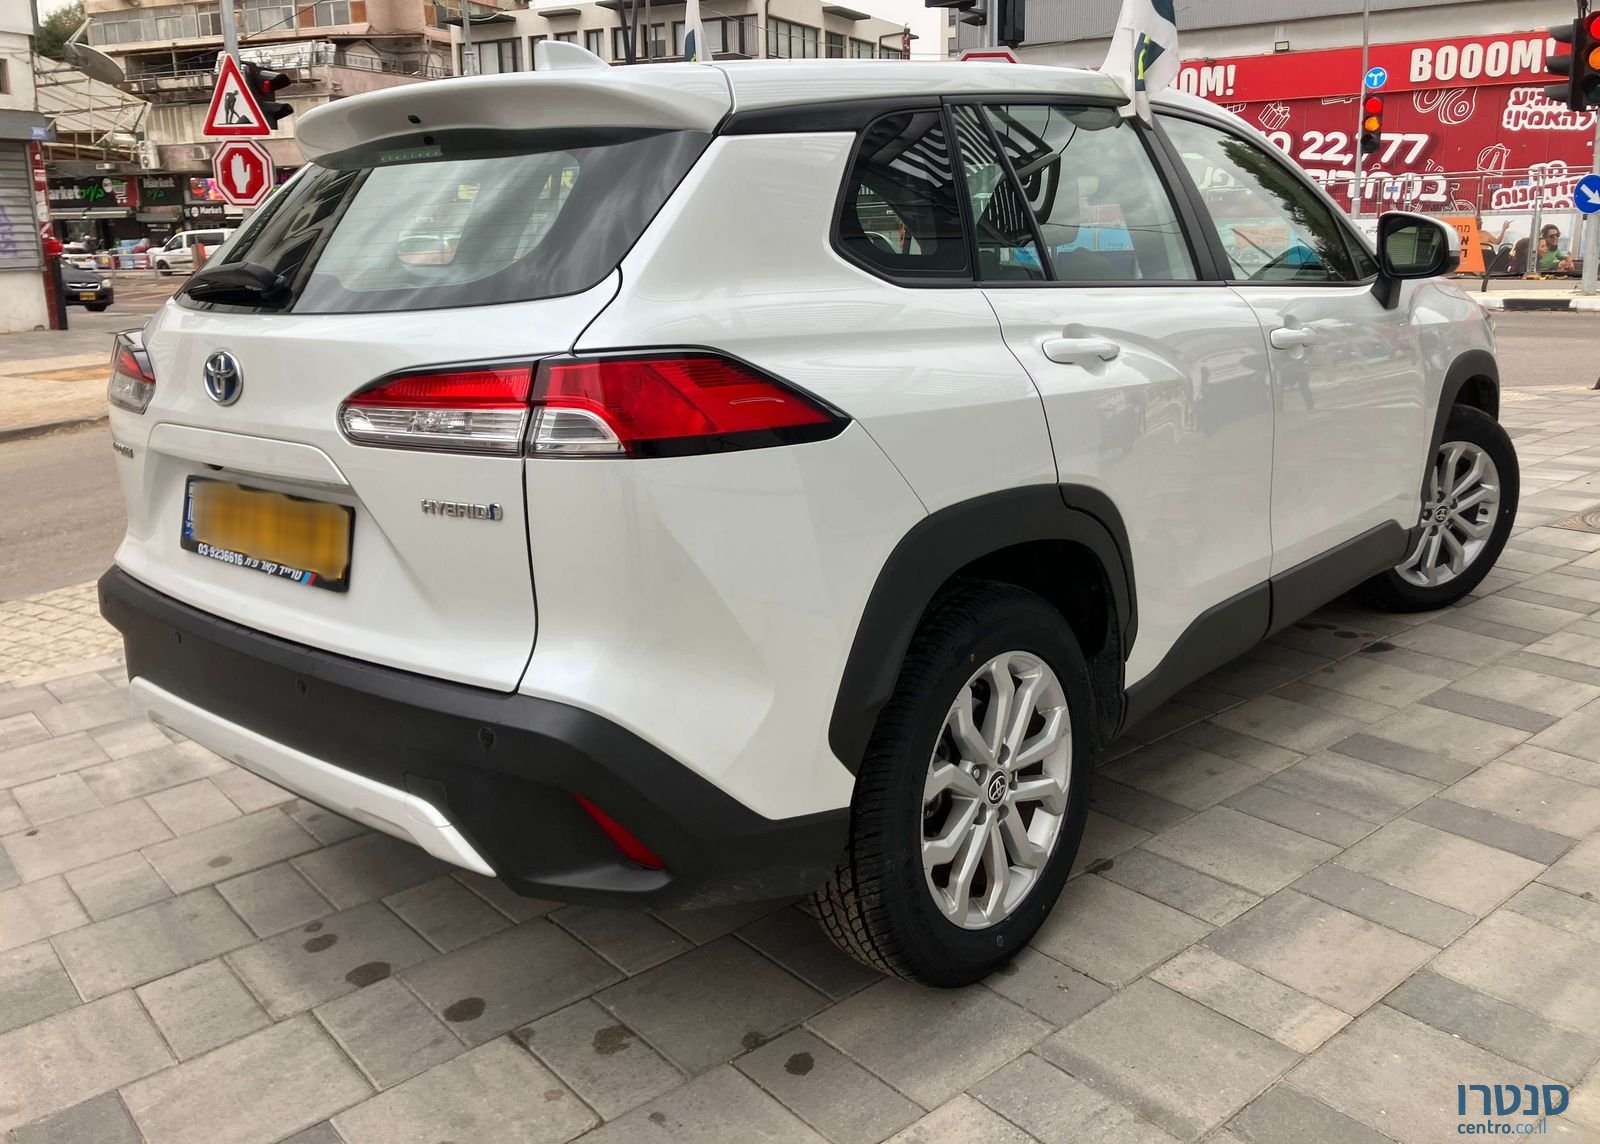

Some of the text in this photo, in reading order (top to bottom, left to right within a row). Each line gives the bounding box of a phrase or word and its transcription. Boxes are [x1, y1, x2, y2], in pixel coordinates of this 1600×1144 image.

[1409, 38, 1557, 83] BOOOM!
[1171, 64, 1236, 97] OM!
[1505, 108, 1594, 128] להאמין!
[1299, 130, 1429, 166] 22,77
[48, 185, 81, 200] arket
[420, 499, 488, 520] HYBRID
